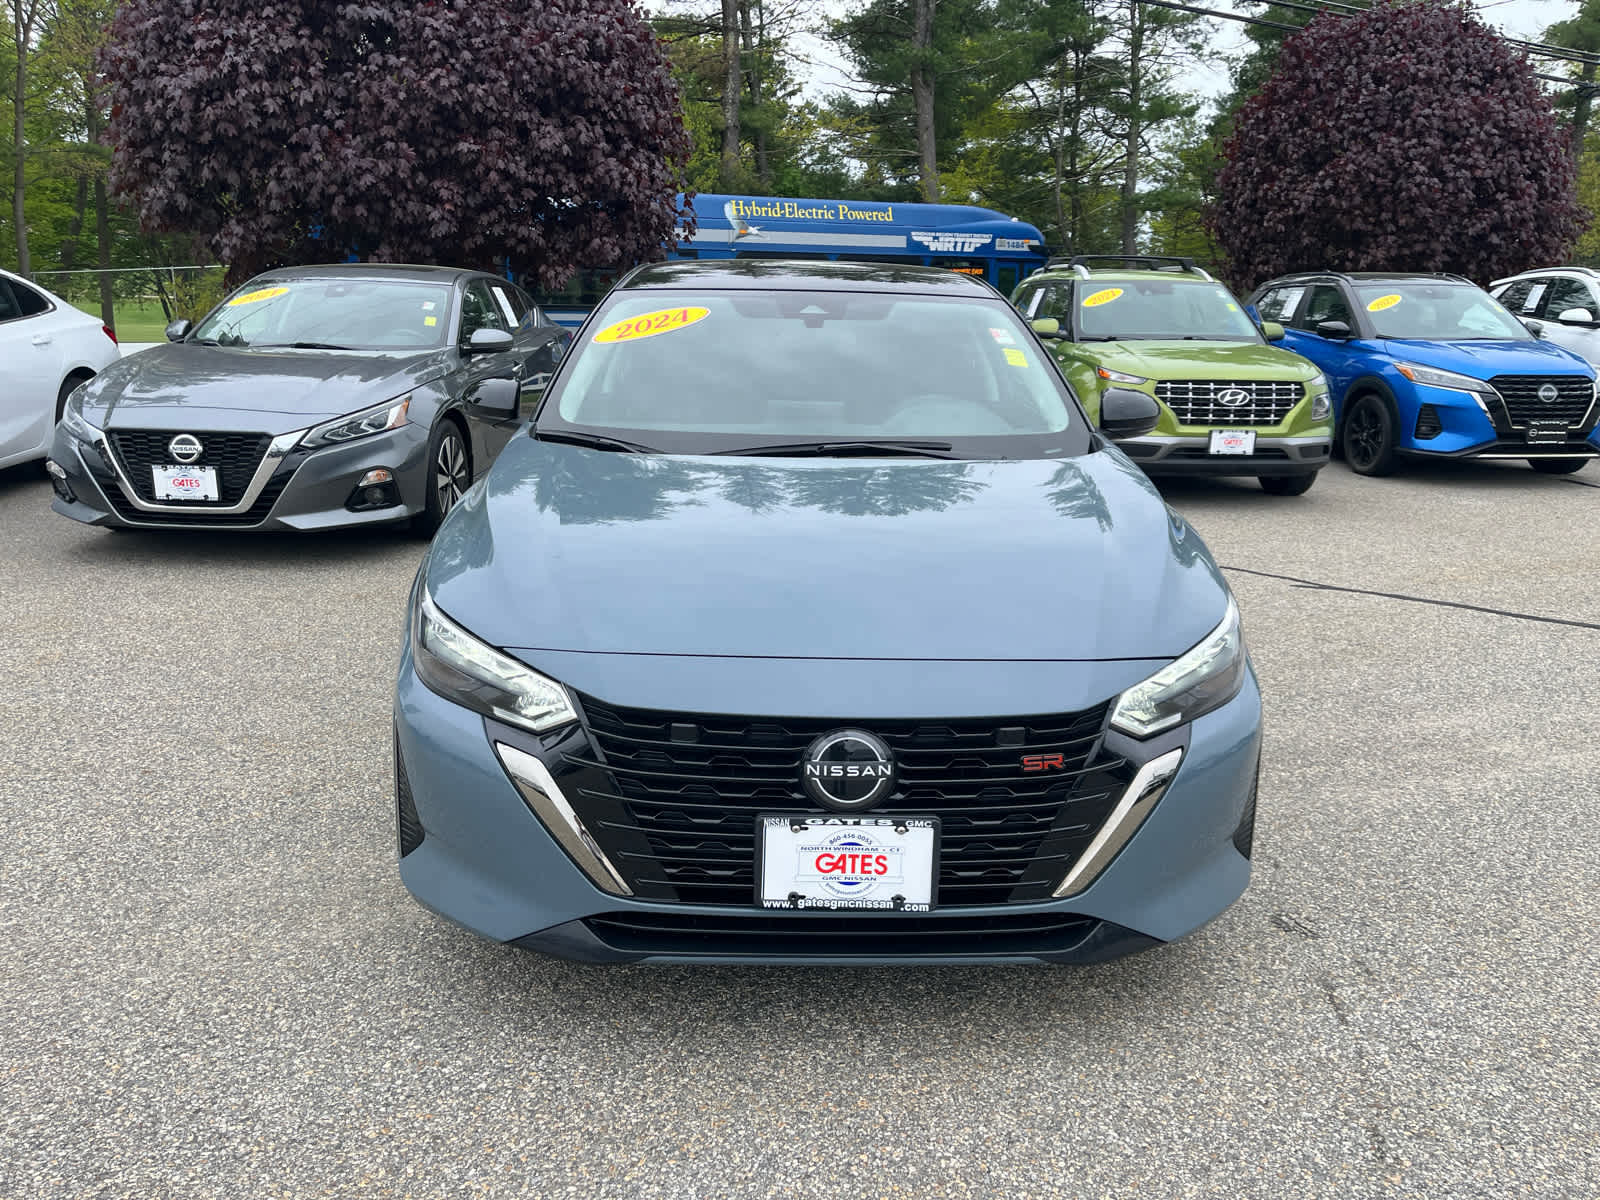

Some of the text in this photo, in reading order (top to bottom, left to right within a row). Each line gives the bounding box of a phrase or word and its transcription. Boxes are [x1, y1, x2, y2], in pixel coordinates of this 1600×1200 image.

[730, 199, 894, 221] Hybrid-Electric Powered
[928, 240, 977, 252] WRTD
[615, 309, 689, 339] 2024
[172, 478, 200, 488] GATES
[1022, 753, 1065, 771] SR
[806, 764, 892, 777] NISSAN
[763, 817, 932, 828] NISSAN GATES GMC
[815, 852, 888, 876] GATES
[763, 897, 930, 912] www. gatesgmcnissan .com
